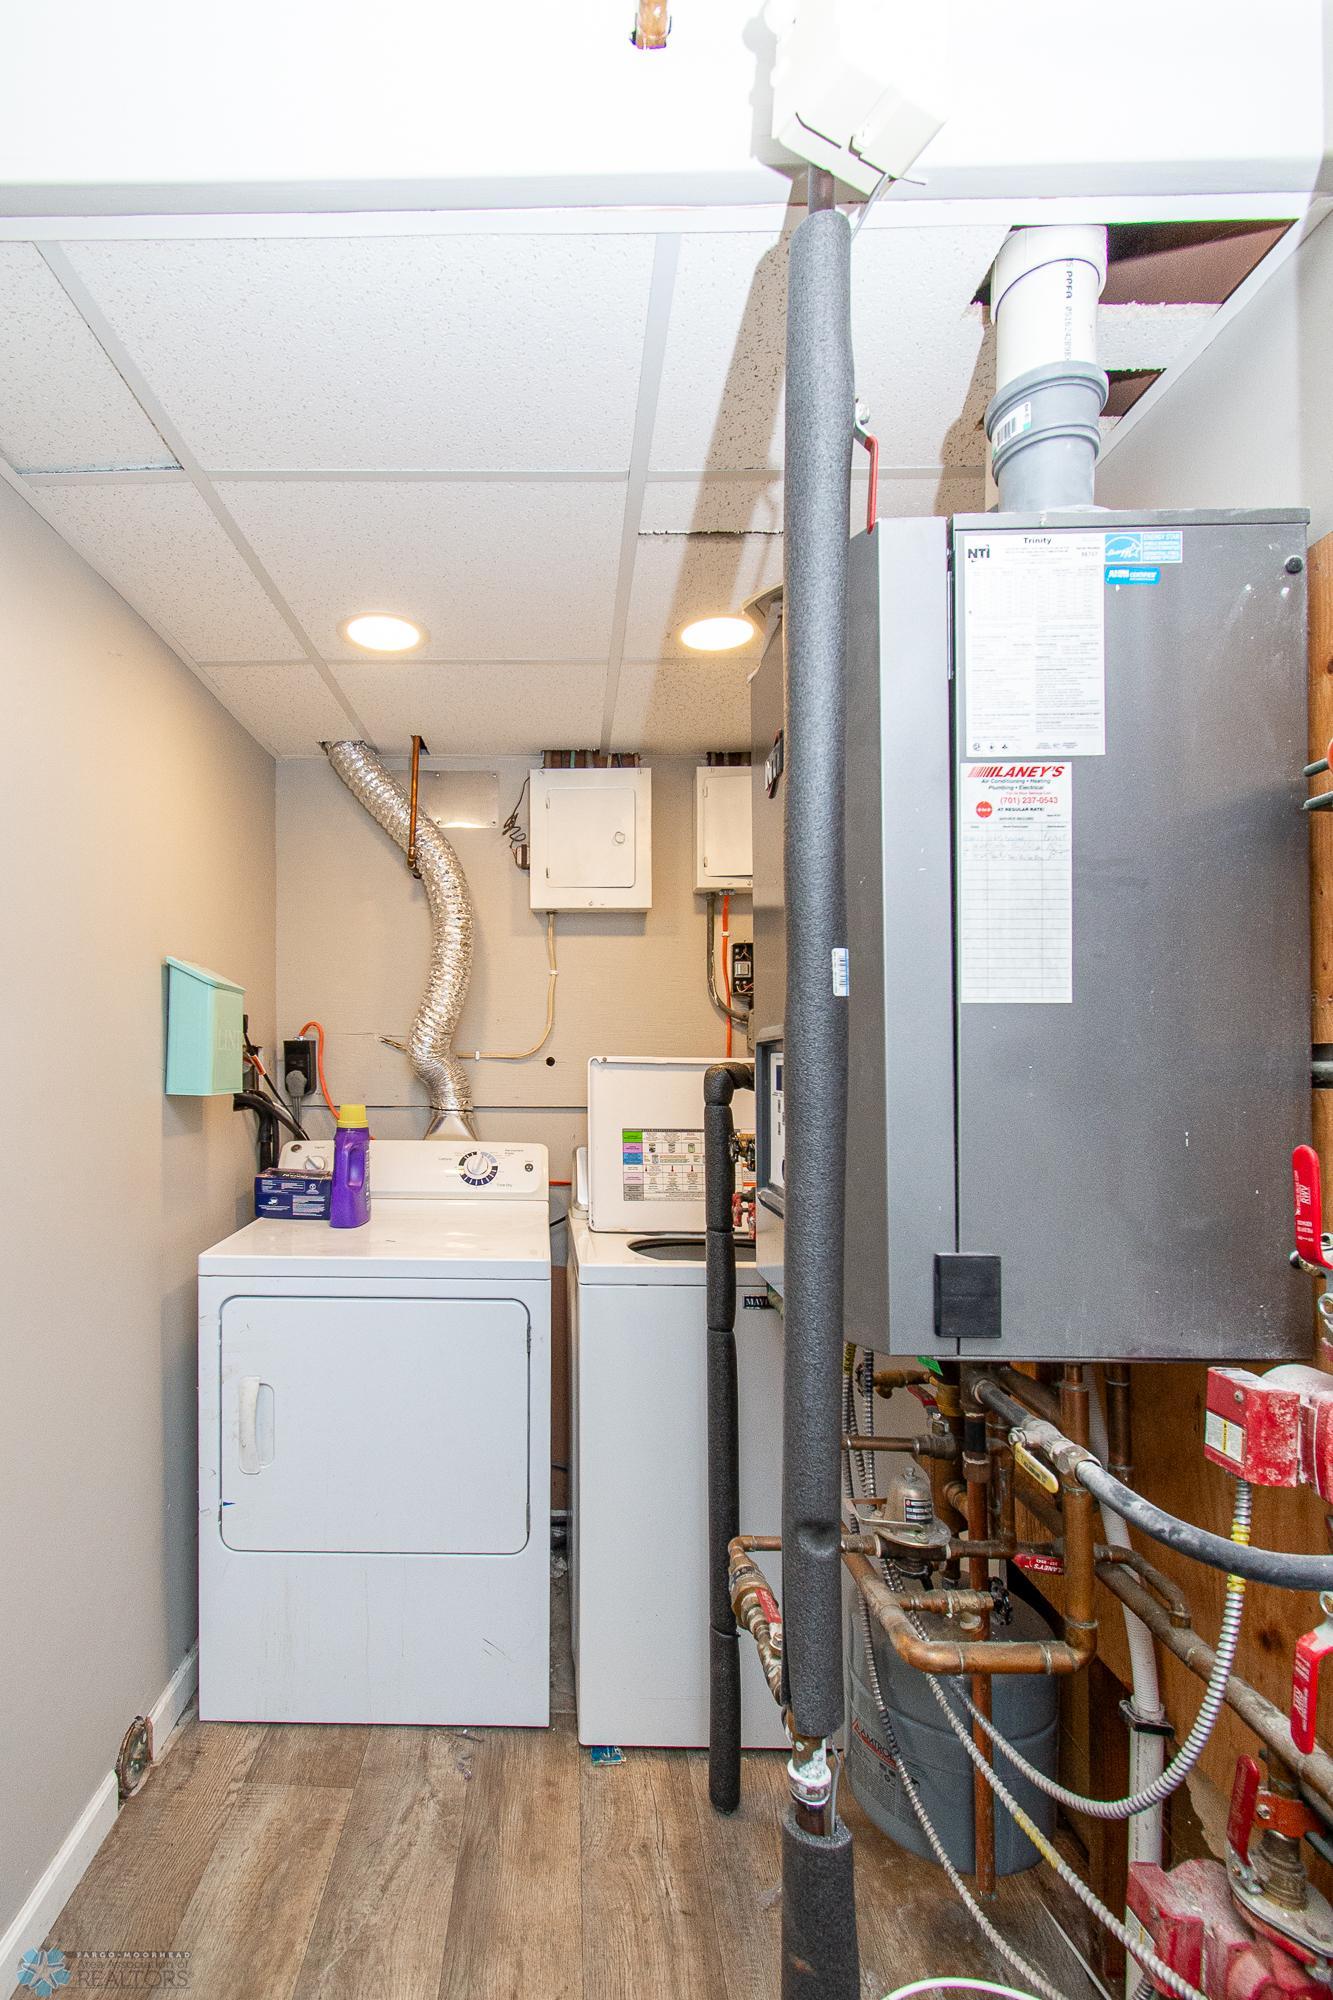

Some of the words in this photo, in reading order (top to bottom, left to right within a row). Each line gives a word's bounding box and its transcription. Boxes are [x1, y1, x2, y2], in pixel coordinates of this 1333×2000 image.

[1023, 537, 1052, 545] Trinity
[996, 765, 1065, 778] LANEY'S
[1000, 796, 1020, 805] (701)
[1022, 796, 1059, 804] 237-0543
